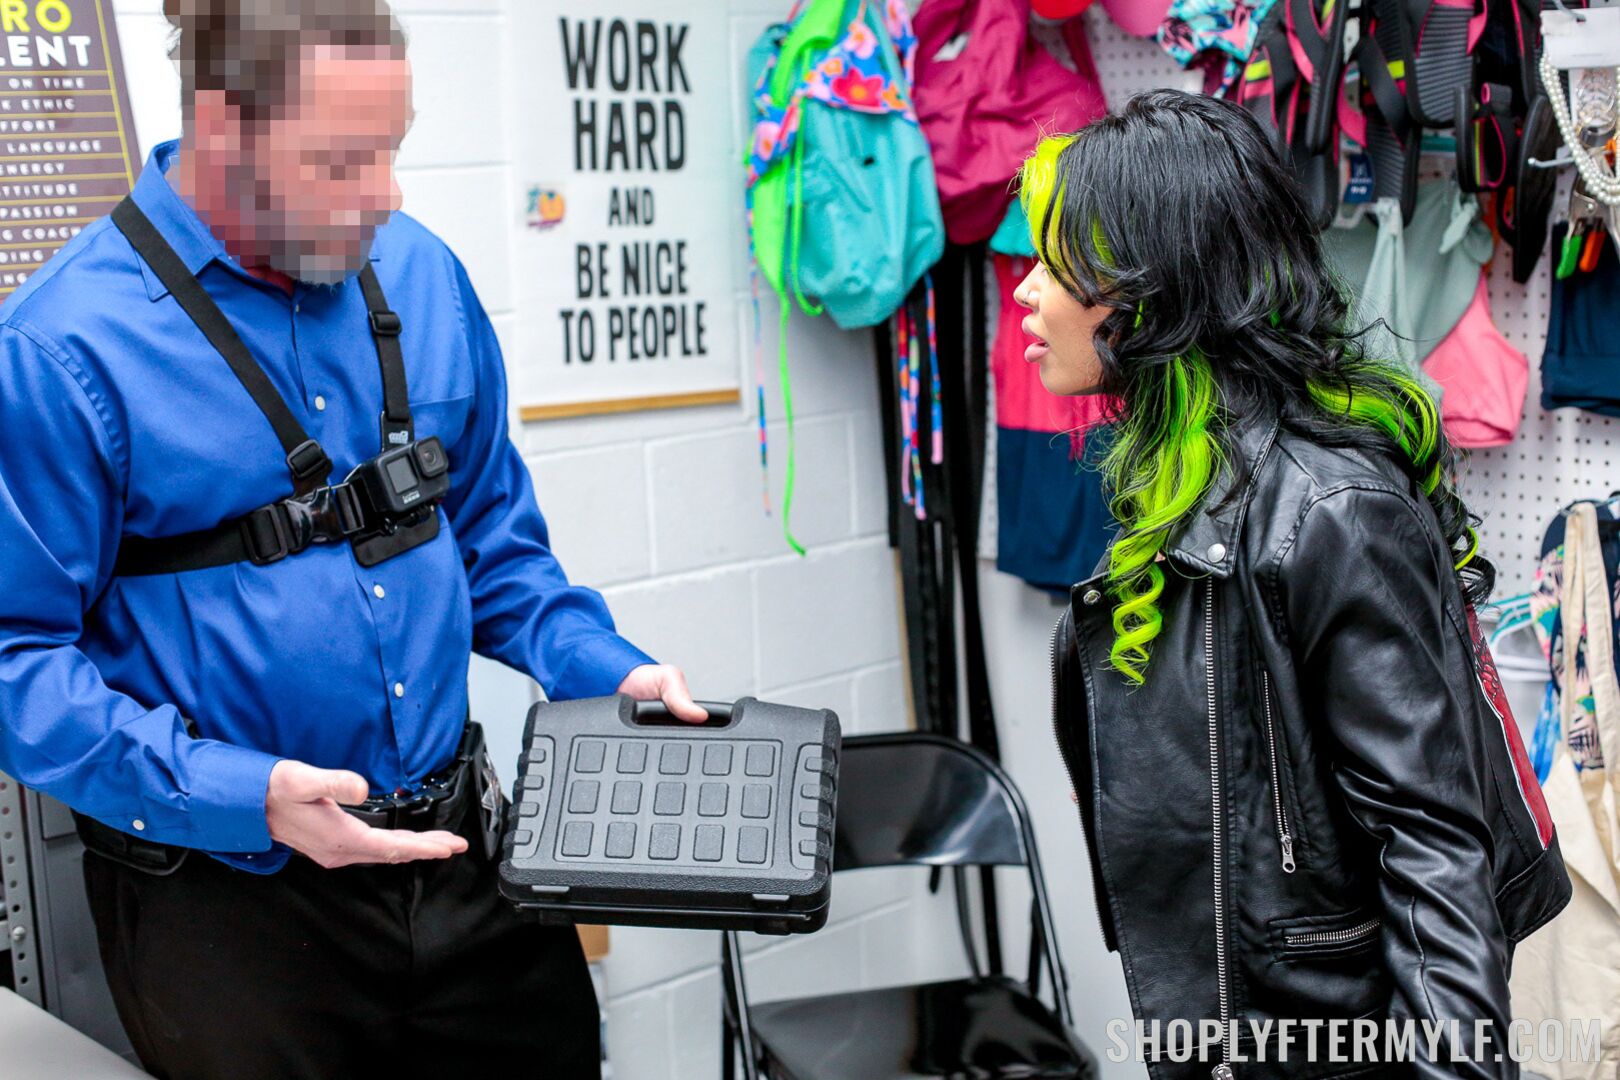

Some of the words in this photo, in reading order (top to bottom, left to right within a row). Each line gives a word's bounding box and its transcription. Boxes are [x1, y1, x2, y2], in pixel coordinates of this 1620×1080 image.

[559, 17, 690, 94] WORK
[43, 77, 84, 89] TIME
[21, 98, 75, 111] ETHIC
[7, 139, 101, 153] LANGUAGE
[574, 99, 687, 171] HARD
[0, 183, 77, 197] TTITUDE
[608, 187, 654, 227] AND
[576, 243, 609, 299] BE
[622, 241, 688, 297] NICE
[560, 309, 596, 364] TO
[608, 303, 708, 362] PEOPLE
